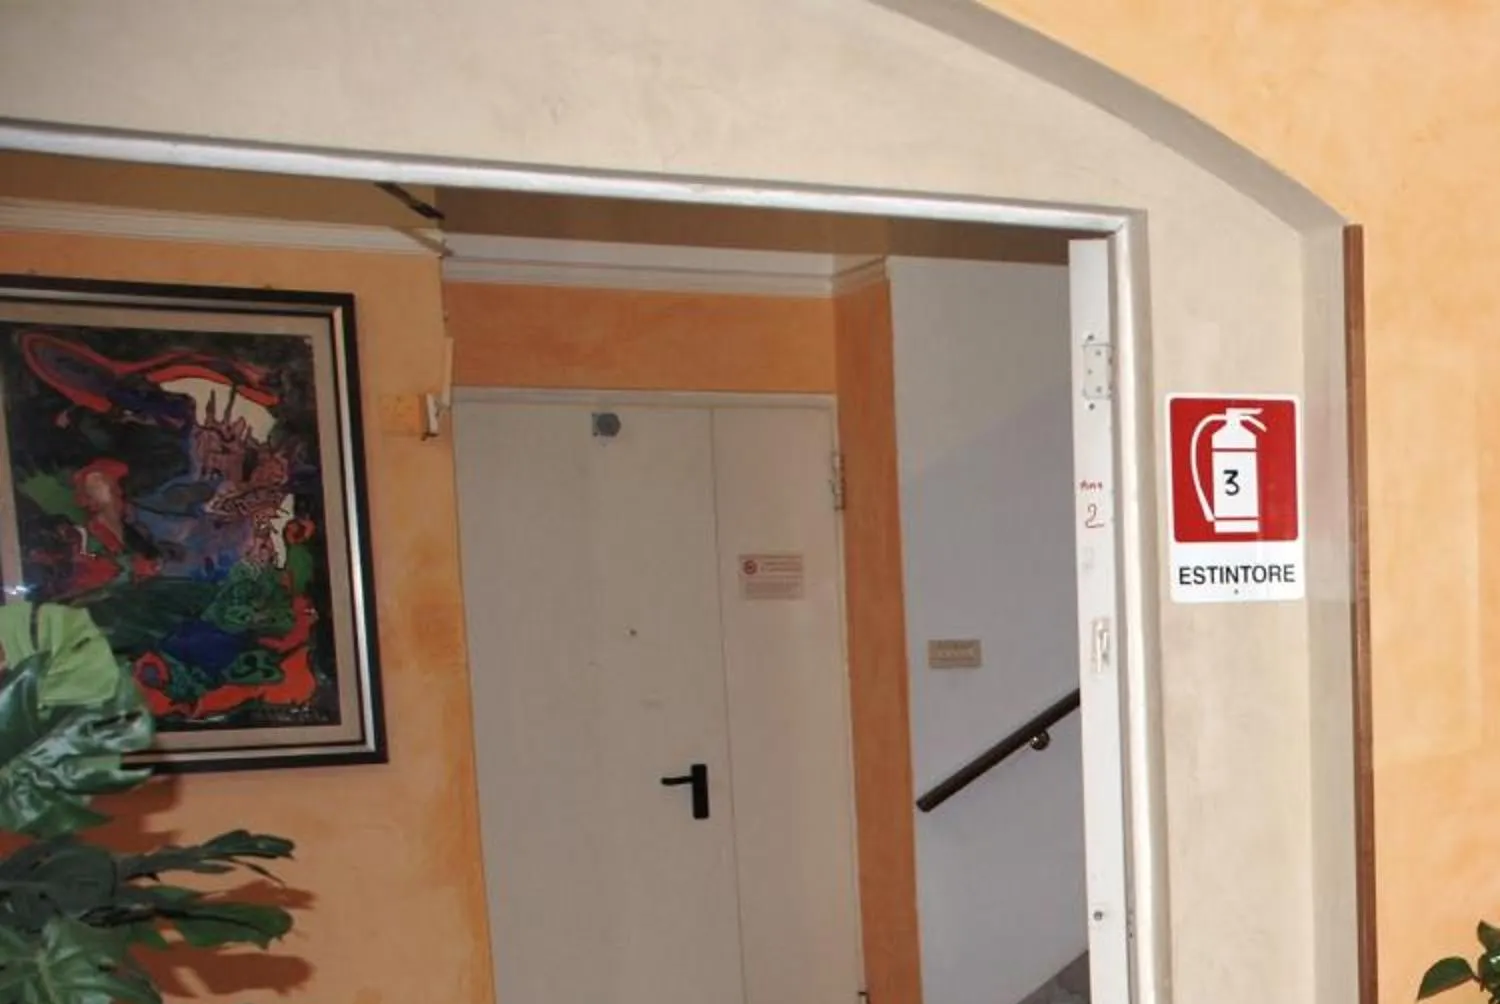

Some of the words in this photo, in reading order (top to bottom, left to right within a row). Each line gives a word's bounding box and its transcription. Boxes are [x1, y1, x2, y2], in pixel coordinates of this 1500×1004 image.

[1222, 469, 1241, 496] 3
[1084, 503, 1105, 529] 2
[1178, 563, 1296, 586] ESTINTORE
